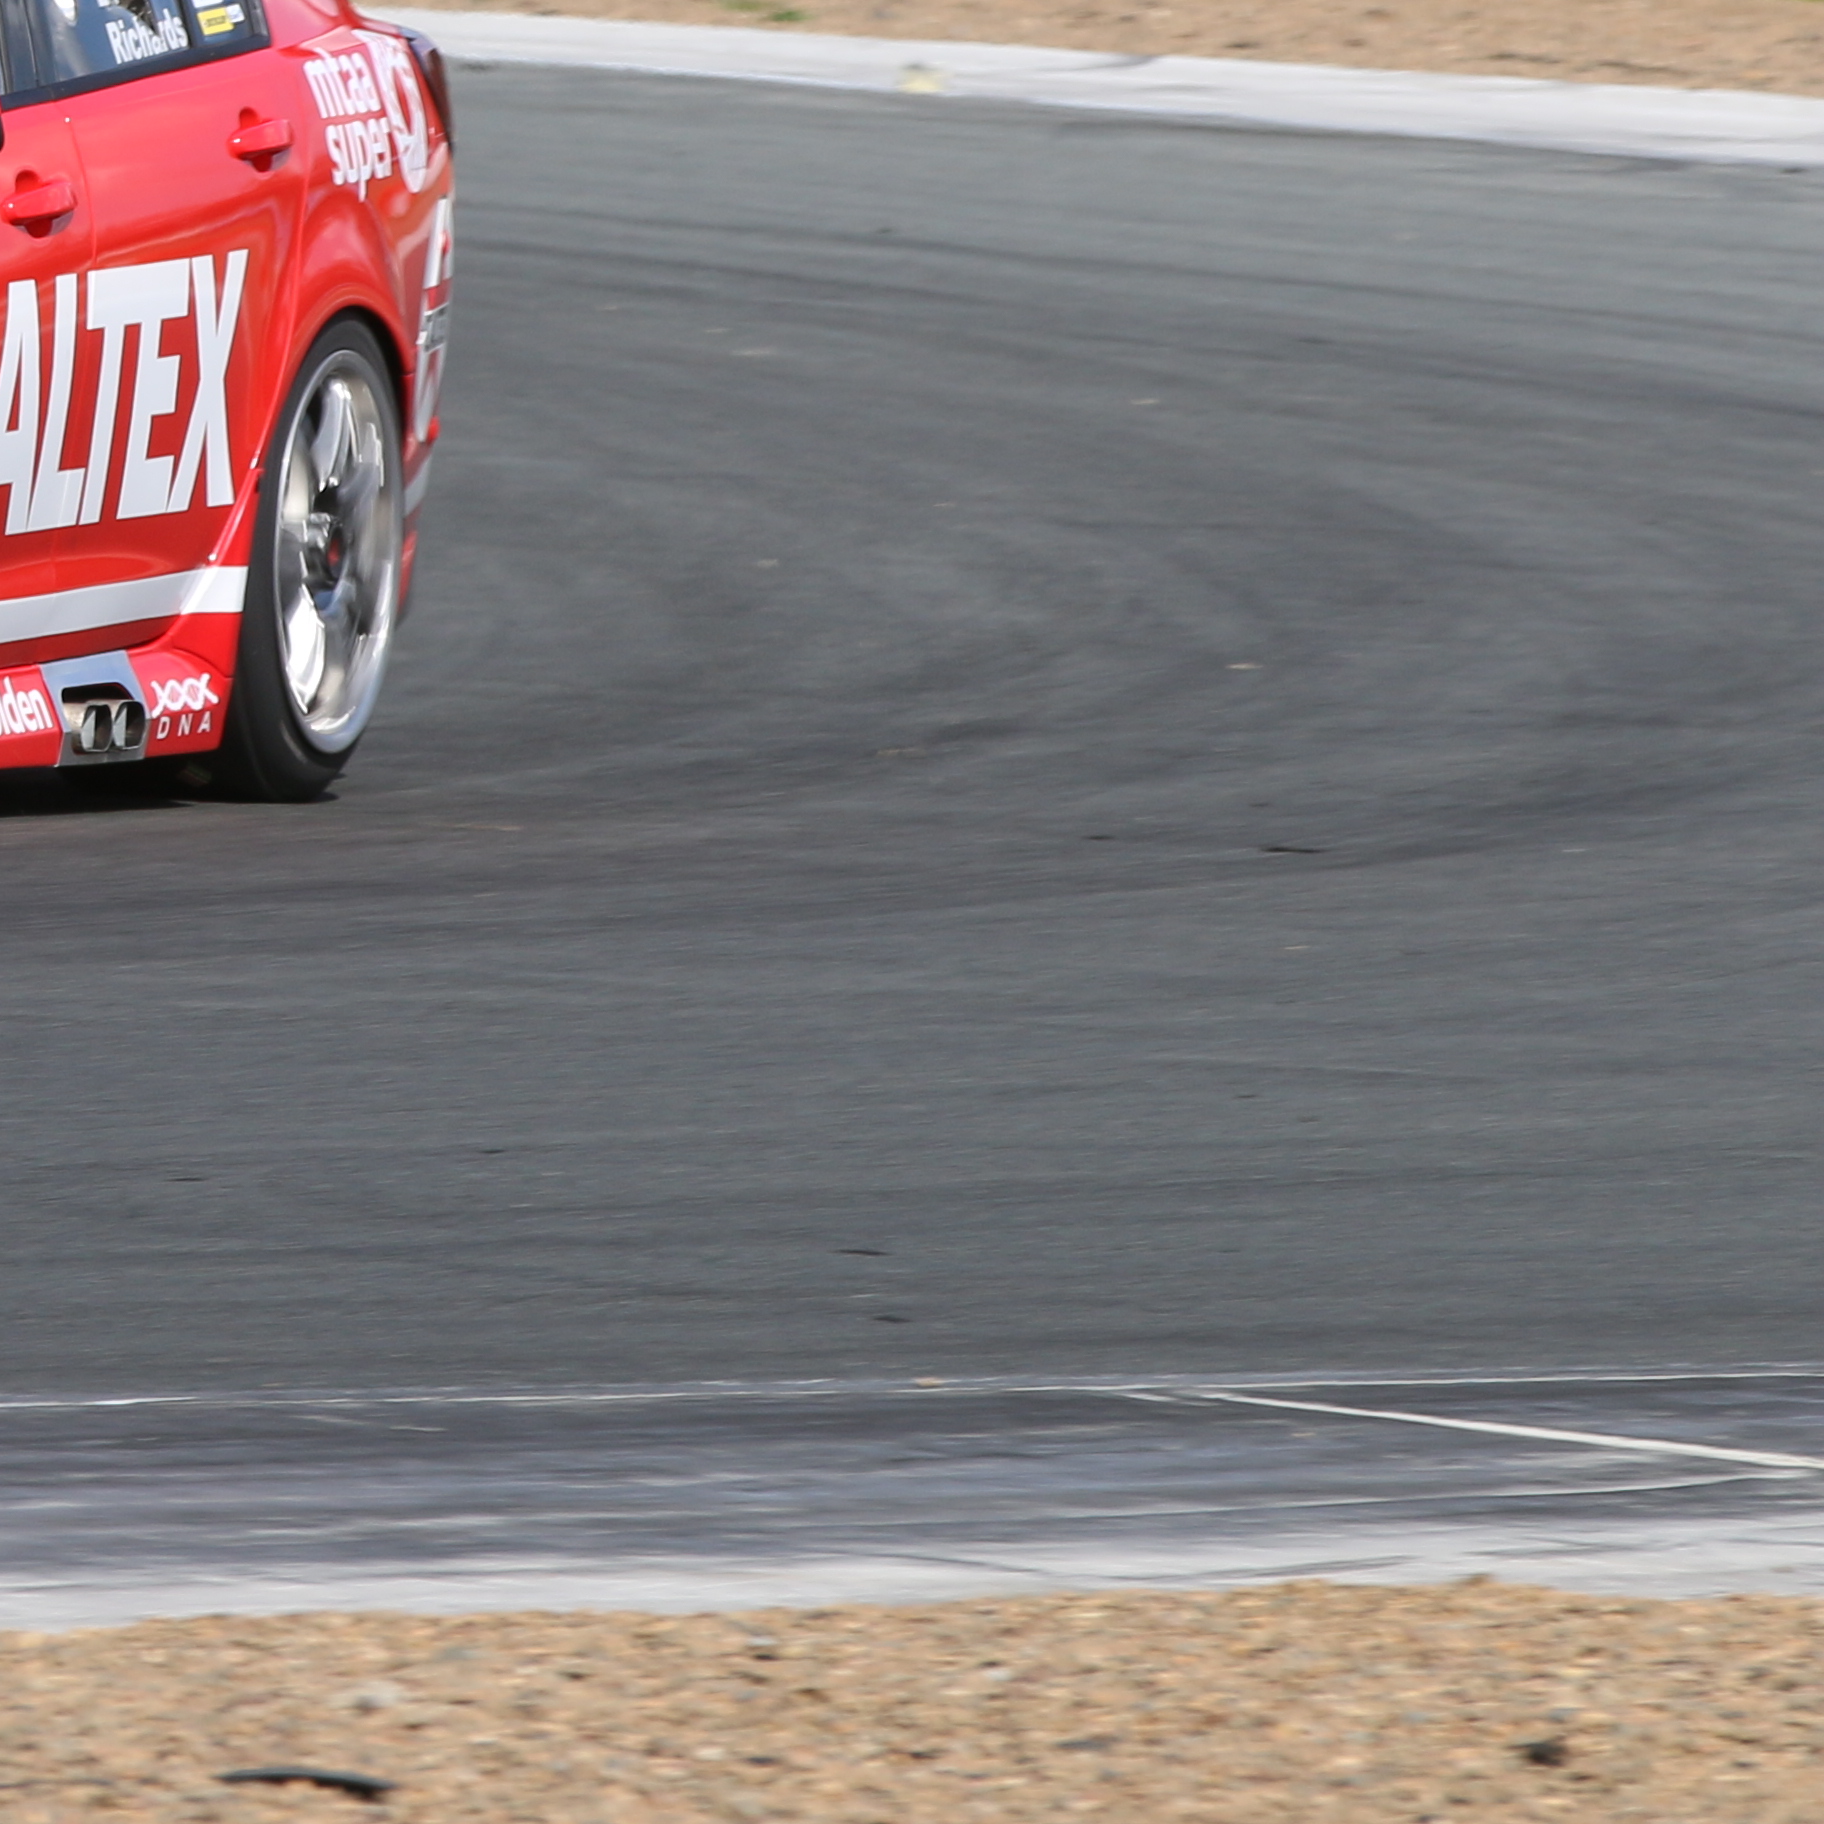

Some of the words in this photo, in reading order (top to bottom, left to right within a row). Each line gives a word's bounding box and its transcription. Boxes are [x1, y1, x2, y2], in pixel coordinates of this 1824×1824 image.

[303, 48, 382, 119] mtaa
[324, 118, 394, 203] super
[156, 710, 212, 740] DNA
